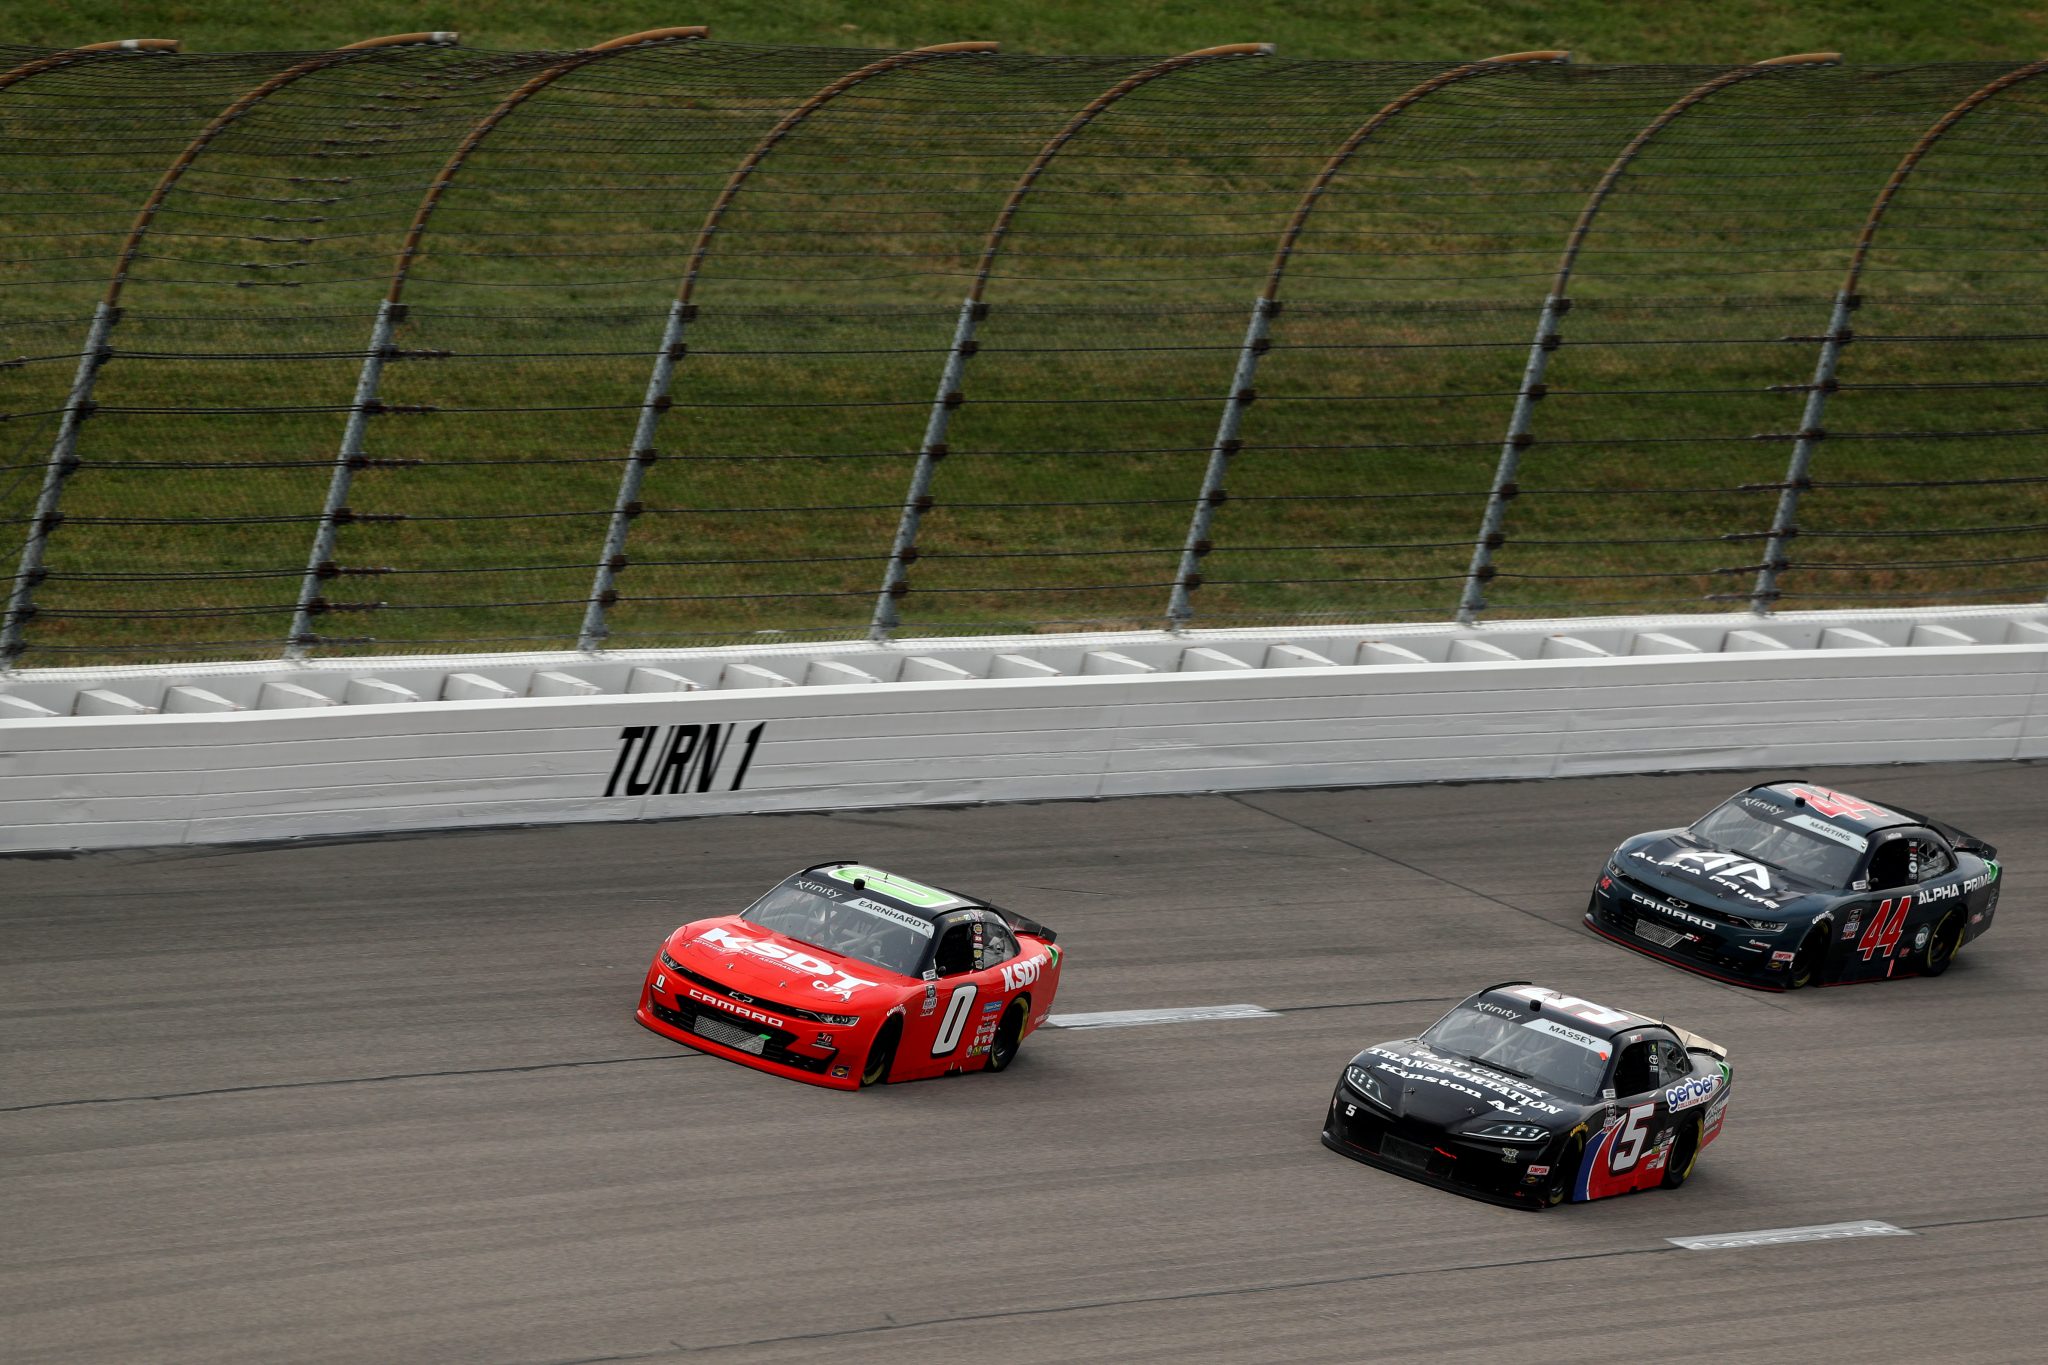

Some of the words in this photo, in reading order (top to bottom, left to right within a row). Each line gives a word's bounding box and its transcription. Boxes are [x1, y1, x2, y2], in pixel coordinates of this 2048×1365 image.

[603, 723, 736, 797] TURN
[729, 721, 767, 791] 1
[1809, 821, 1851, 841] MARTINS
[1629, 852, 1700, 875] ALPHA
[1708, 875, 1780, 909] PRIME
[1918, 883, 1959, 905] ALPHA
[858, 900, 930, 930] EARNHARDT
[1631, 893, 1716, 930] CAMARO
[1857, 895, 1912, 961] 44
[700, 928, 879, 991] KSDT
[1000, 954, 1045, 992] KSDT
[656, 974, 665, 988] 0
[812, 980, 853, 1000] CPA
[689, 989, 784, 1027] CAMARO
[931, 984, 977, 1055] 0
[1549, 1025, 1596, 1046] MASSEY
[1364, 1048, 1563, 1114] TRANSPORTATION
[1375, 1062, 1482, 1099] Kinston
[1486, 1100, 1524, 1116] AL
[1409, 1050, 1469, 1069] FLAT
[1471, 1067, 1552, 1098] CREEK
[1345, 1105, 1357, 1117] 5
[1667, 1075, 1715, 1112] gerber
[1612, 1103, 1655, 1171] 5
